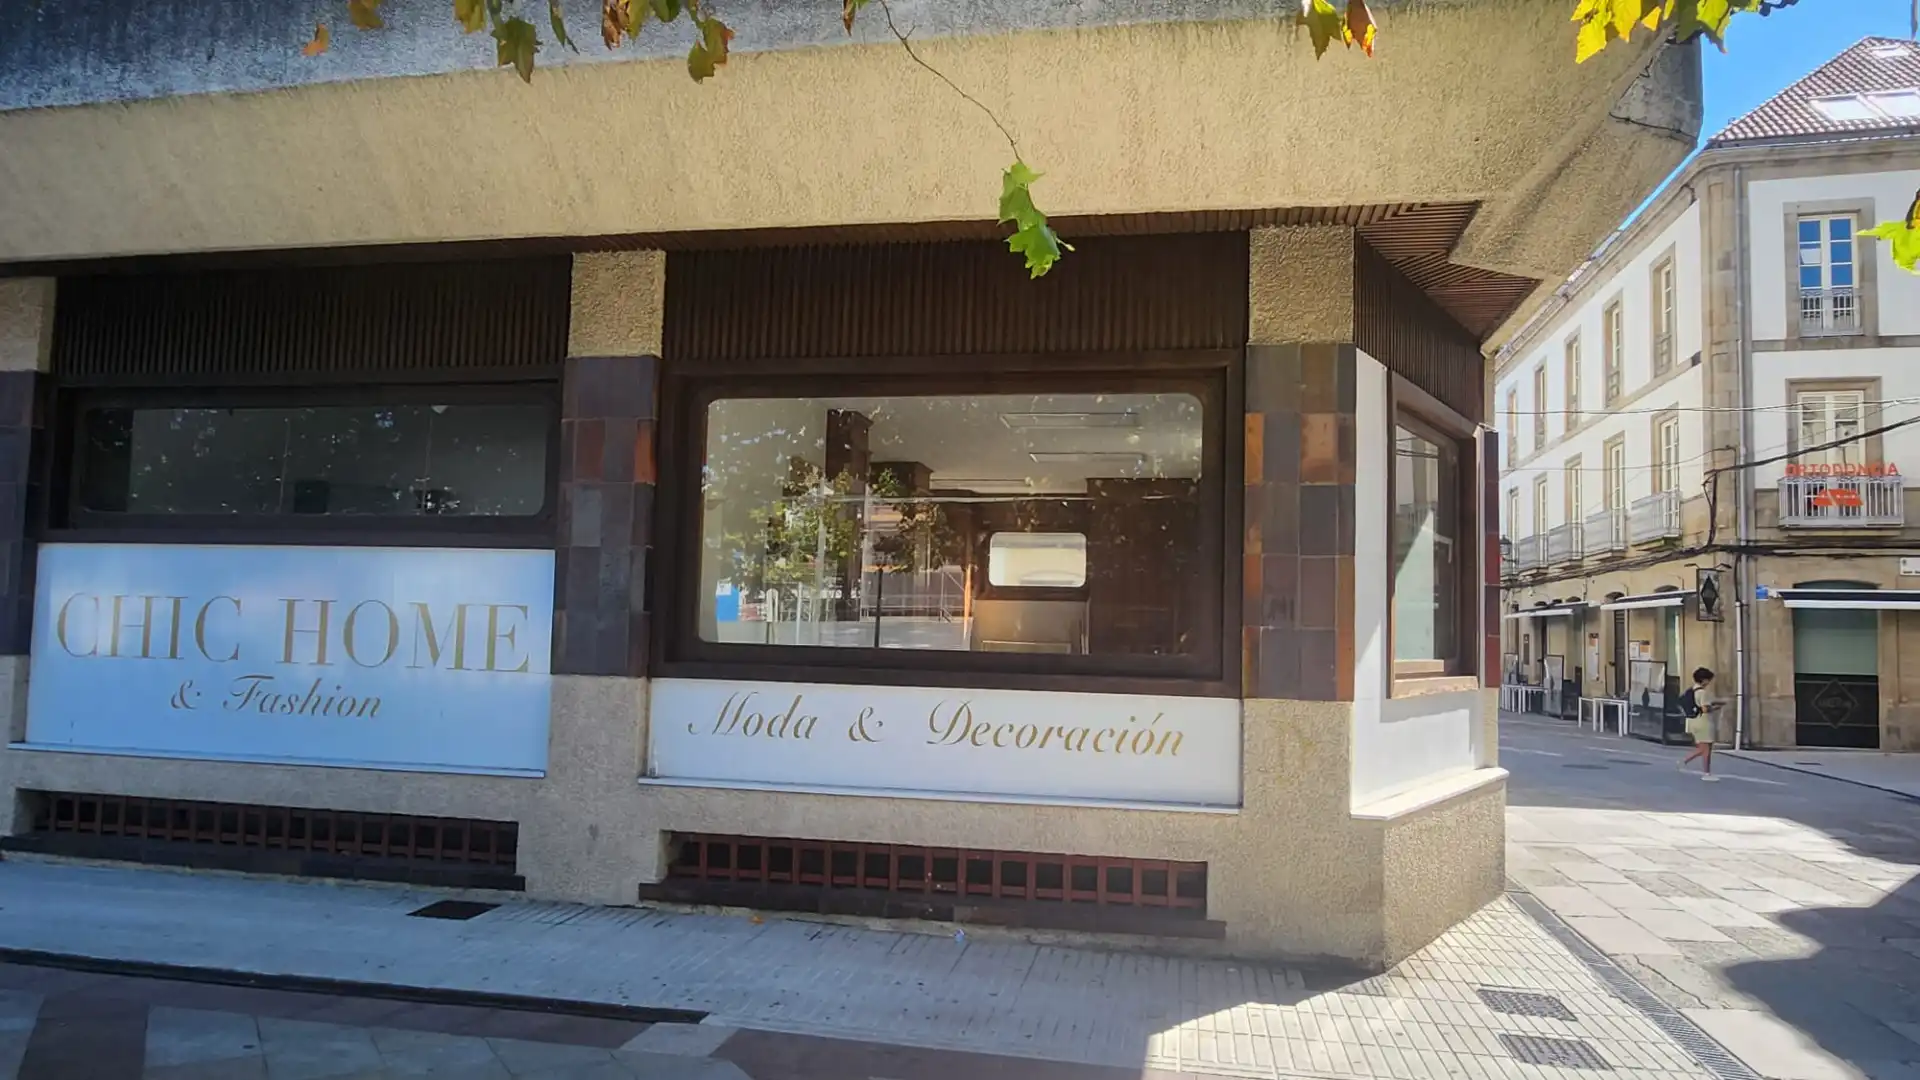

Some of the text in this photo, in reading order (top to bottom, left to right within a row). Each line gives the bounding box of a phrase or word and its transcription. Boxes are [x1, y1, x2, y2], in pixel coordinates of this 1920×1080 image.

[1785, 462, 1899, 476] ORTODONCIA
[56, 592, 530, 673] CHIC HOME
[171, 674, 382, 719] & Fashion
[688, 691, 1184, 757] Moda & Decoración
